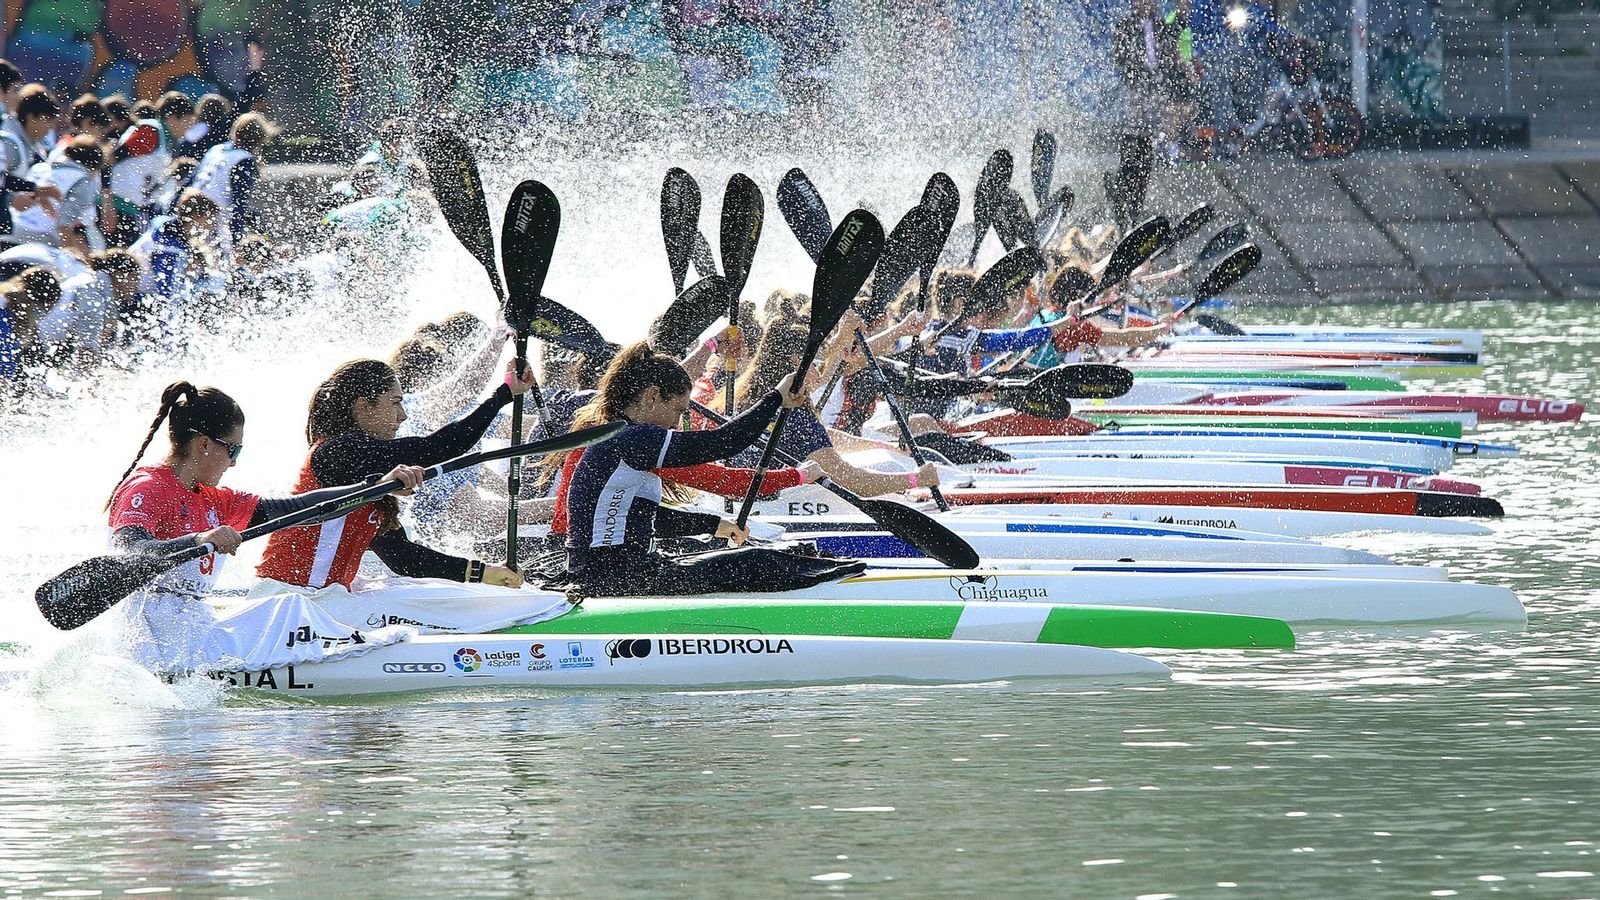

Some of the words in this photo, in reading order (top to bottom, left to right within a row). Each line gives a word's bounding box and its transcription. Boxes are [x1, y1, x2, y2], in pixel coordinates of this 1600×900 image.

[788, 502, 830, 516] ESP
[957, 585, 1048, 602] Chiguagua
[658, 638, 794, 655] IBERDROLA
[484, 650, 521, 661] LaLiga
[384, 664, 445, 673] NELO
[287, 665, 314, 690] L.
